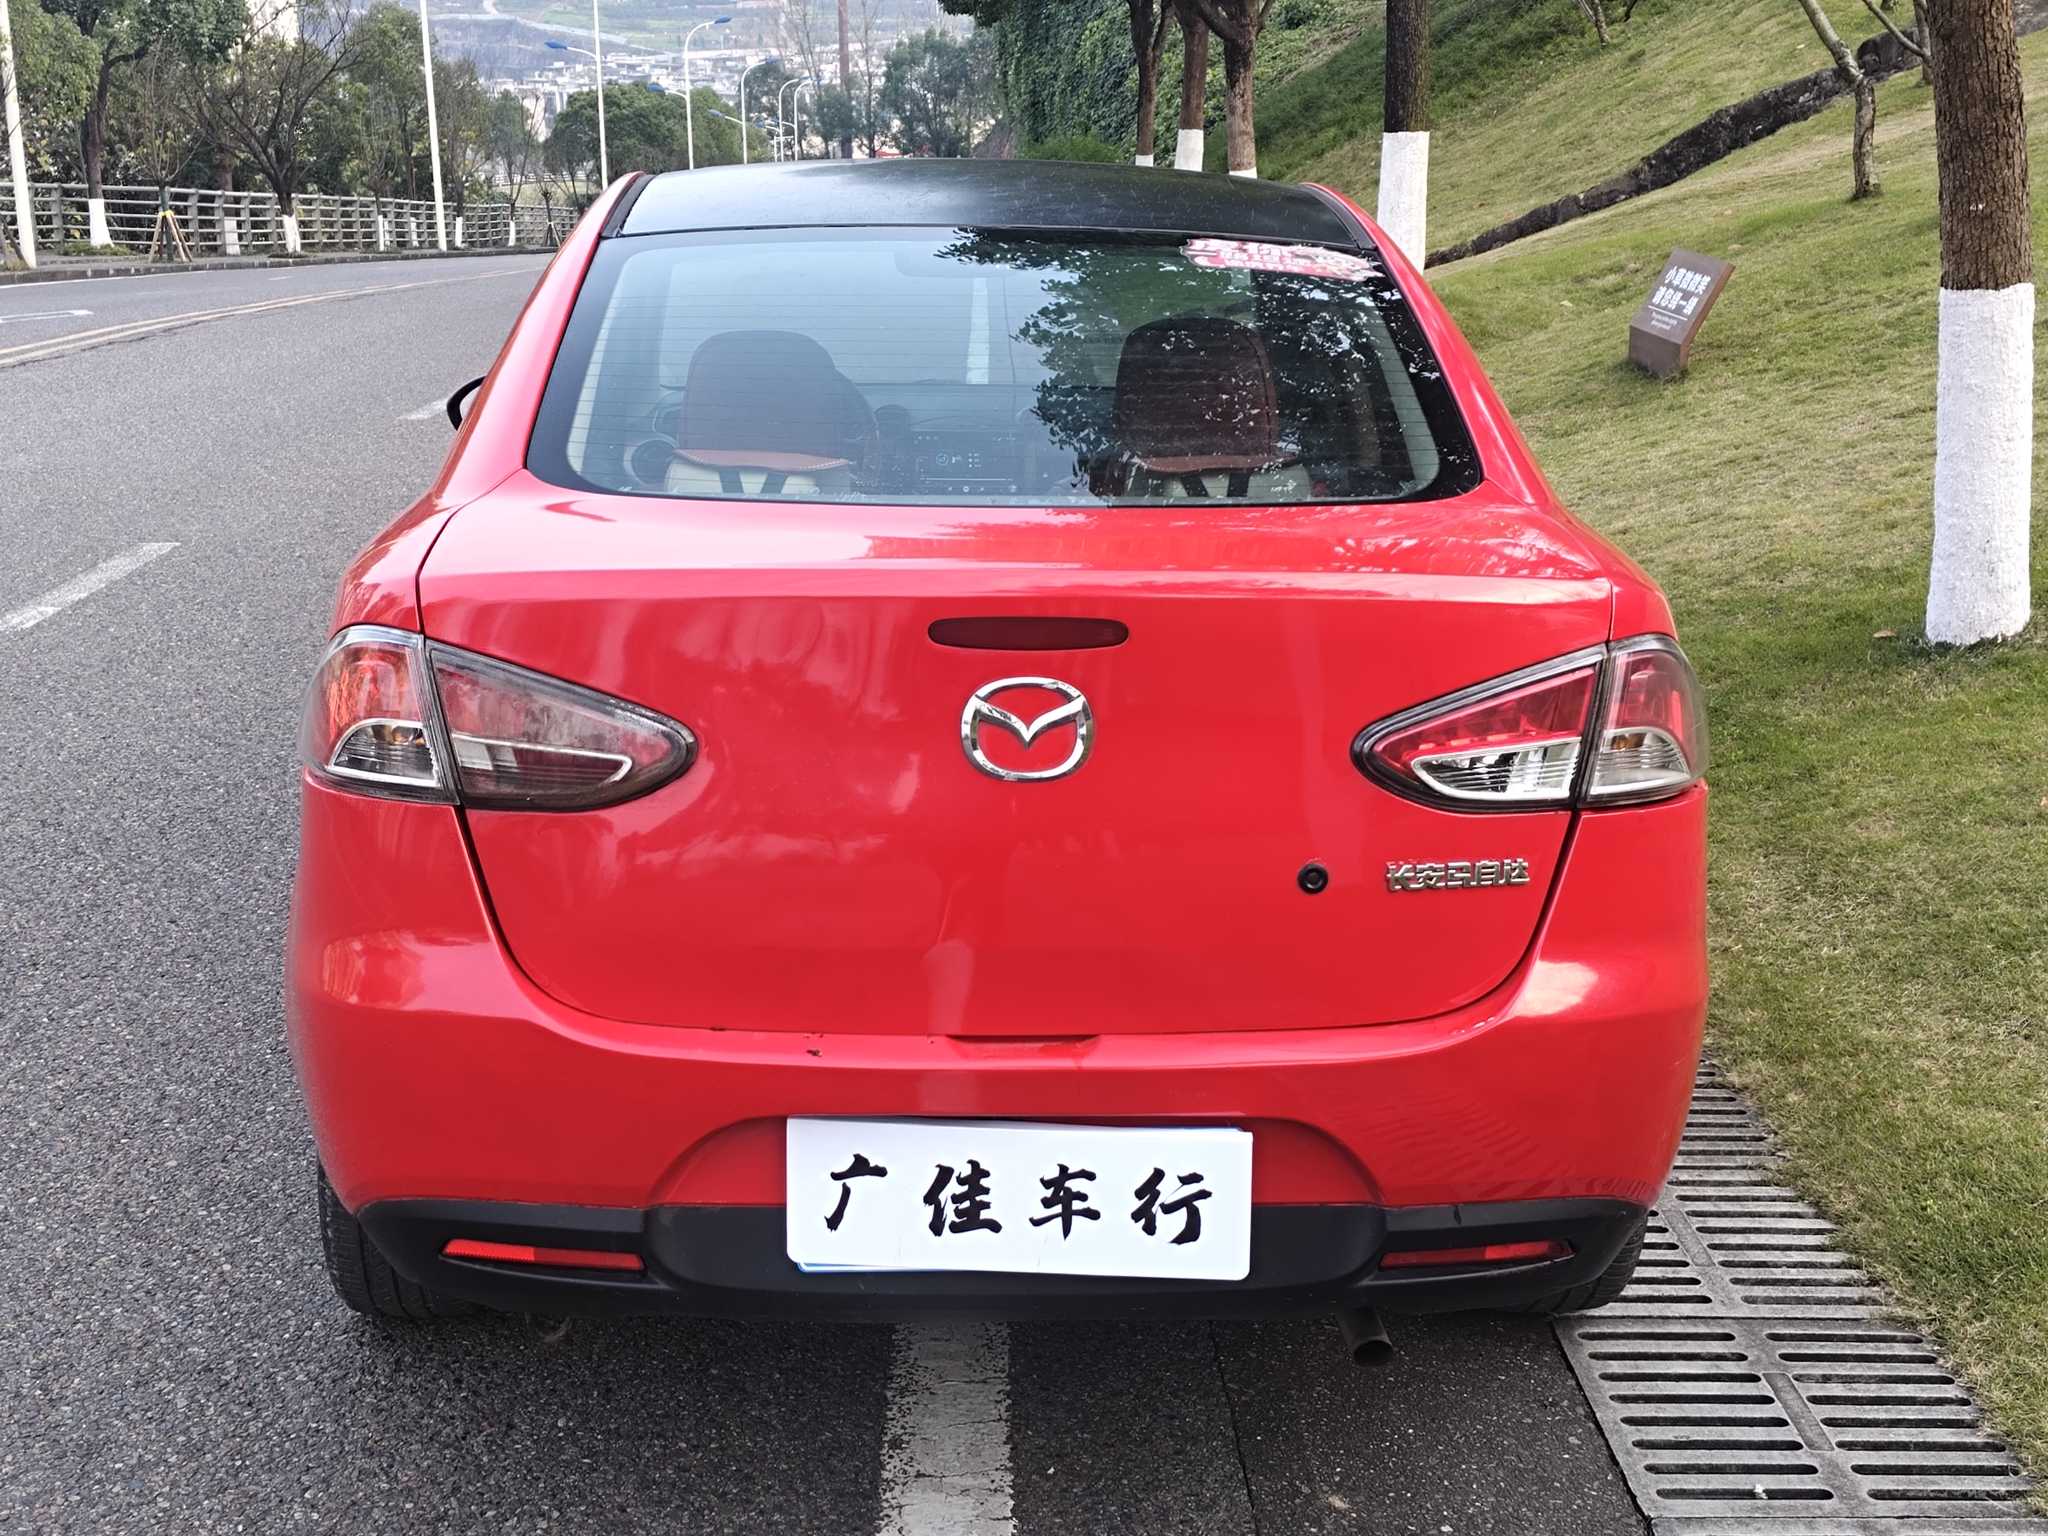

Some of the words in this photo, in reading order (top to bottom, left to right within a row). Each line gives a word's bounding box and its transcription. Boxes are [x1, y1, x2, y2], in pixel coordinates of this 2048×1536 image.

[1386, 858, 1530, 892] 长安马自达
[824, 1153, 1213, 1245] 广佳车行
